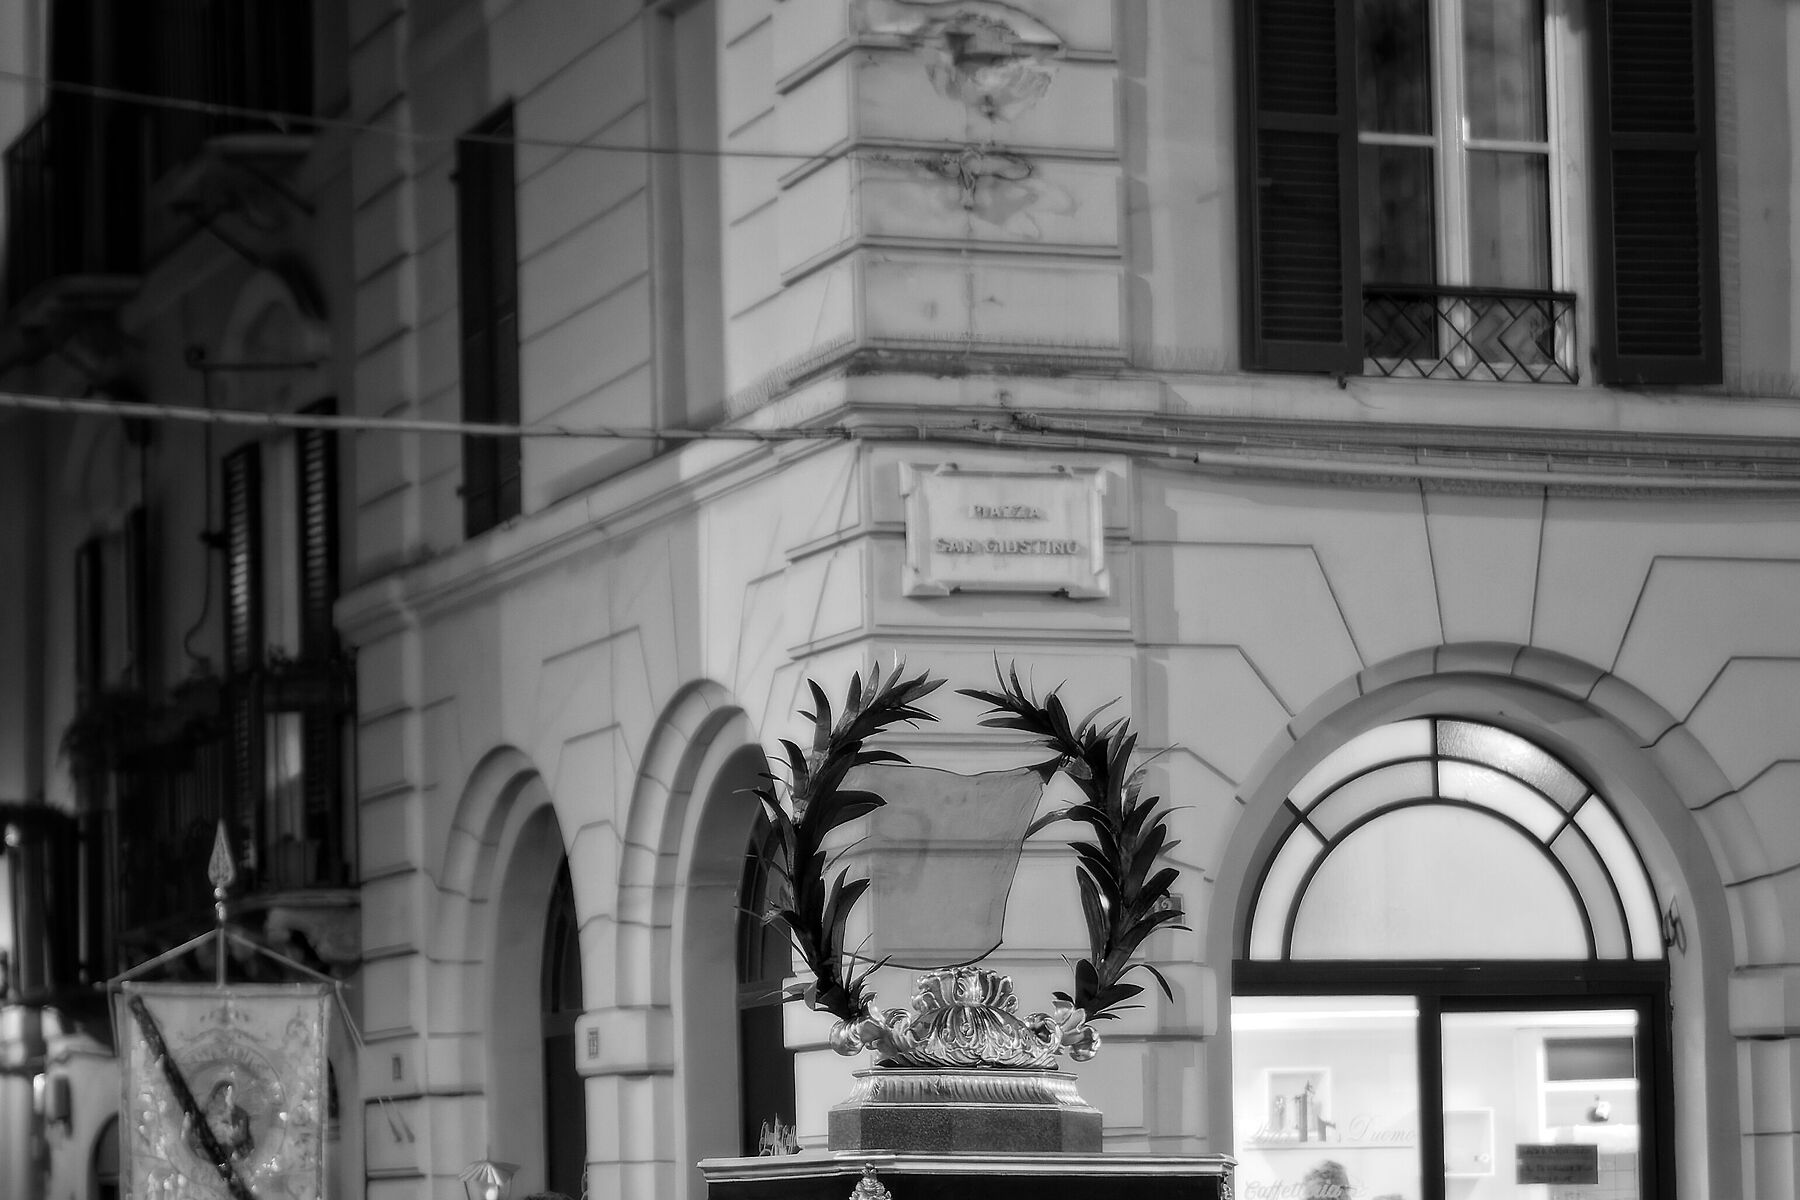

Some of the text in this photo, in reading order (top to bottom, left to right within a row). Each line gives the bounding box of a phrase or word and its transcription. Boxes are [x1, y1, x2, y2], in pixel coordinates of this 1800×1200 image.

[967, 504, 1042, 520] PIAZZA
[936, 537, 1080, 556] SAN GIUSTINO
[1346, 1113, 1417, 1144] Duomo
